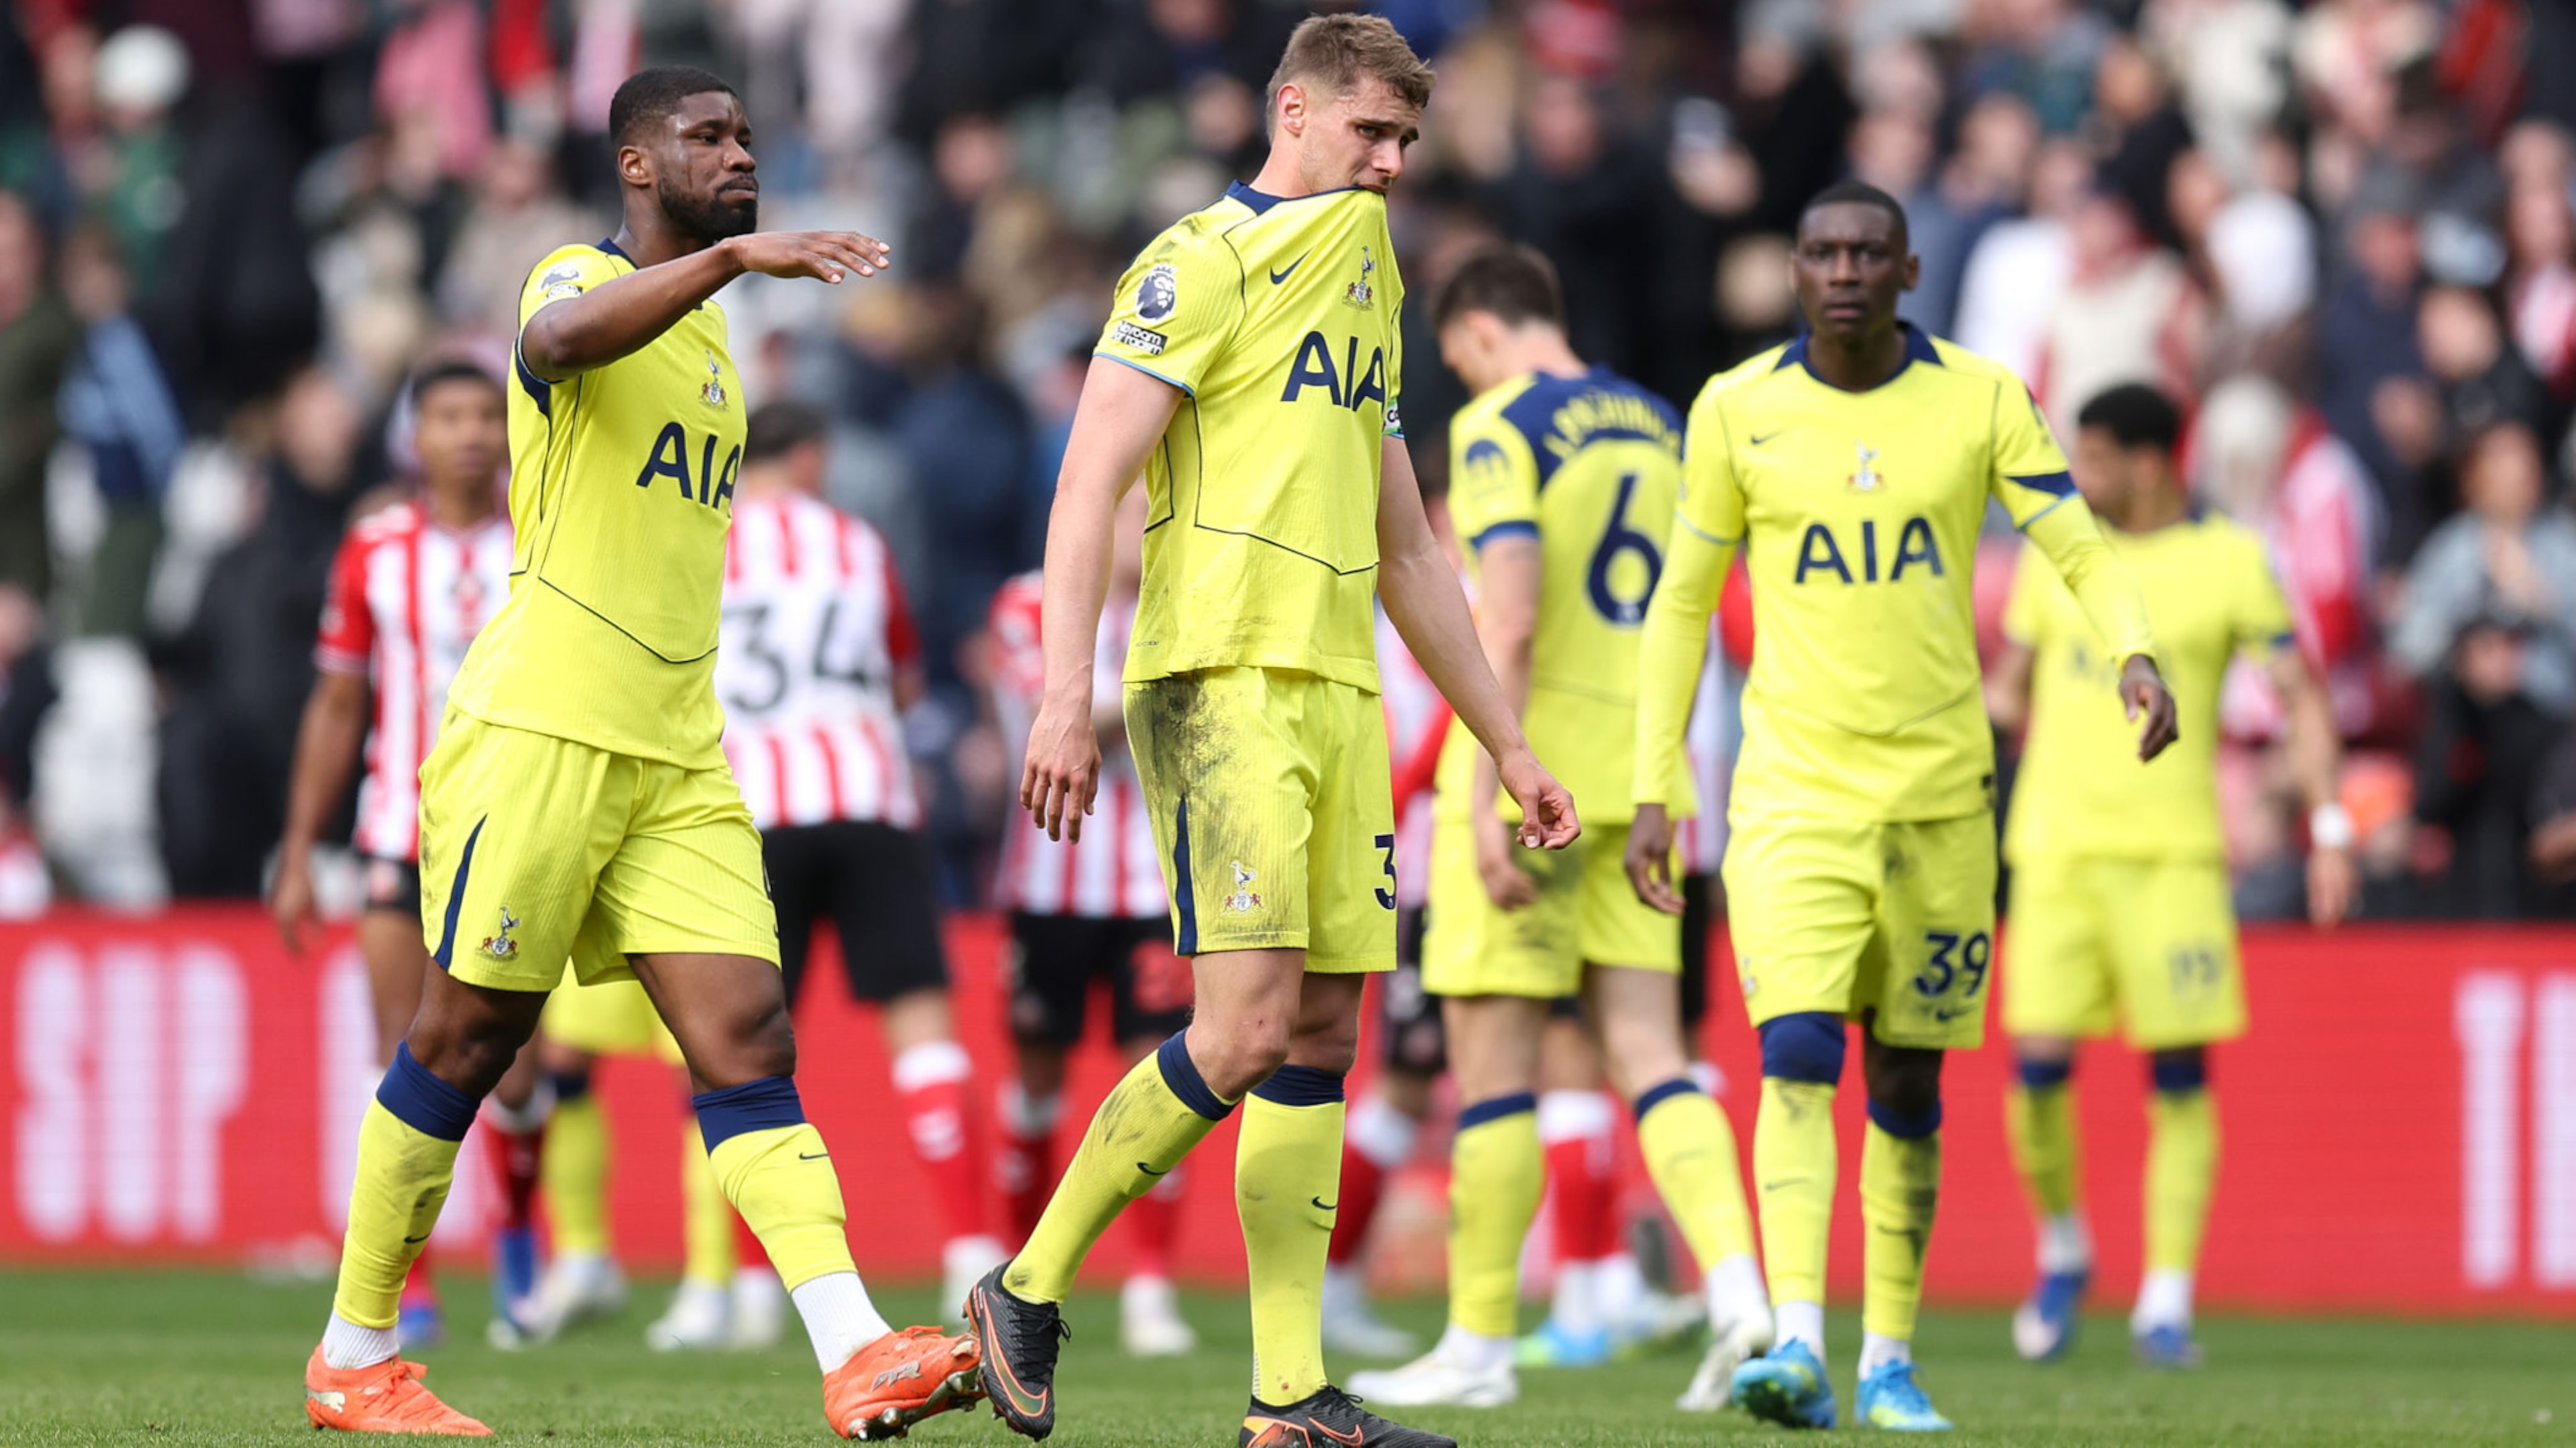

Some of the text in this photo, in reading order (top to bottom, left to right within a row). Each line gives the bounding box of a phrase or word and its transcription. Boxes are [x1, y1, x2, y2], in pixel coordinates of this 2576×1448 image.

[1129, 327, 1162, 345] room
[1281, 331, 1385, 411] AIA
[636, 422, 741, 508] AIA
[1586, 473, 1664, 626] 6
[1794, 517, 1943, 583] AIA
[721, 599, 873, 714] 34
[1913, 931, 1990, 998] 39
